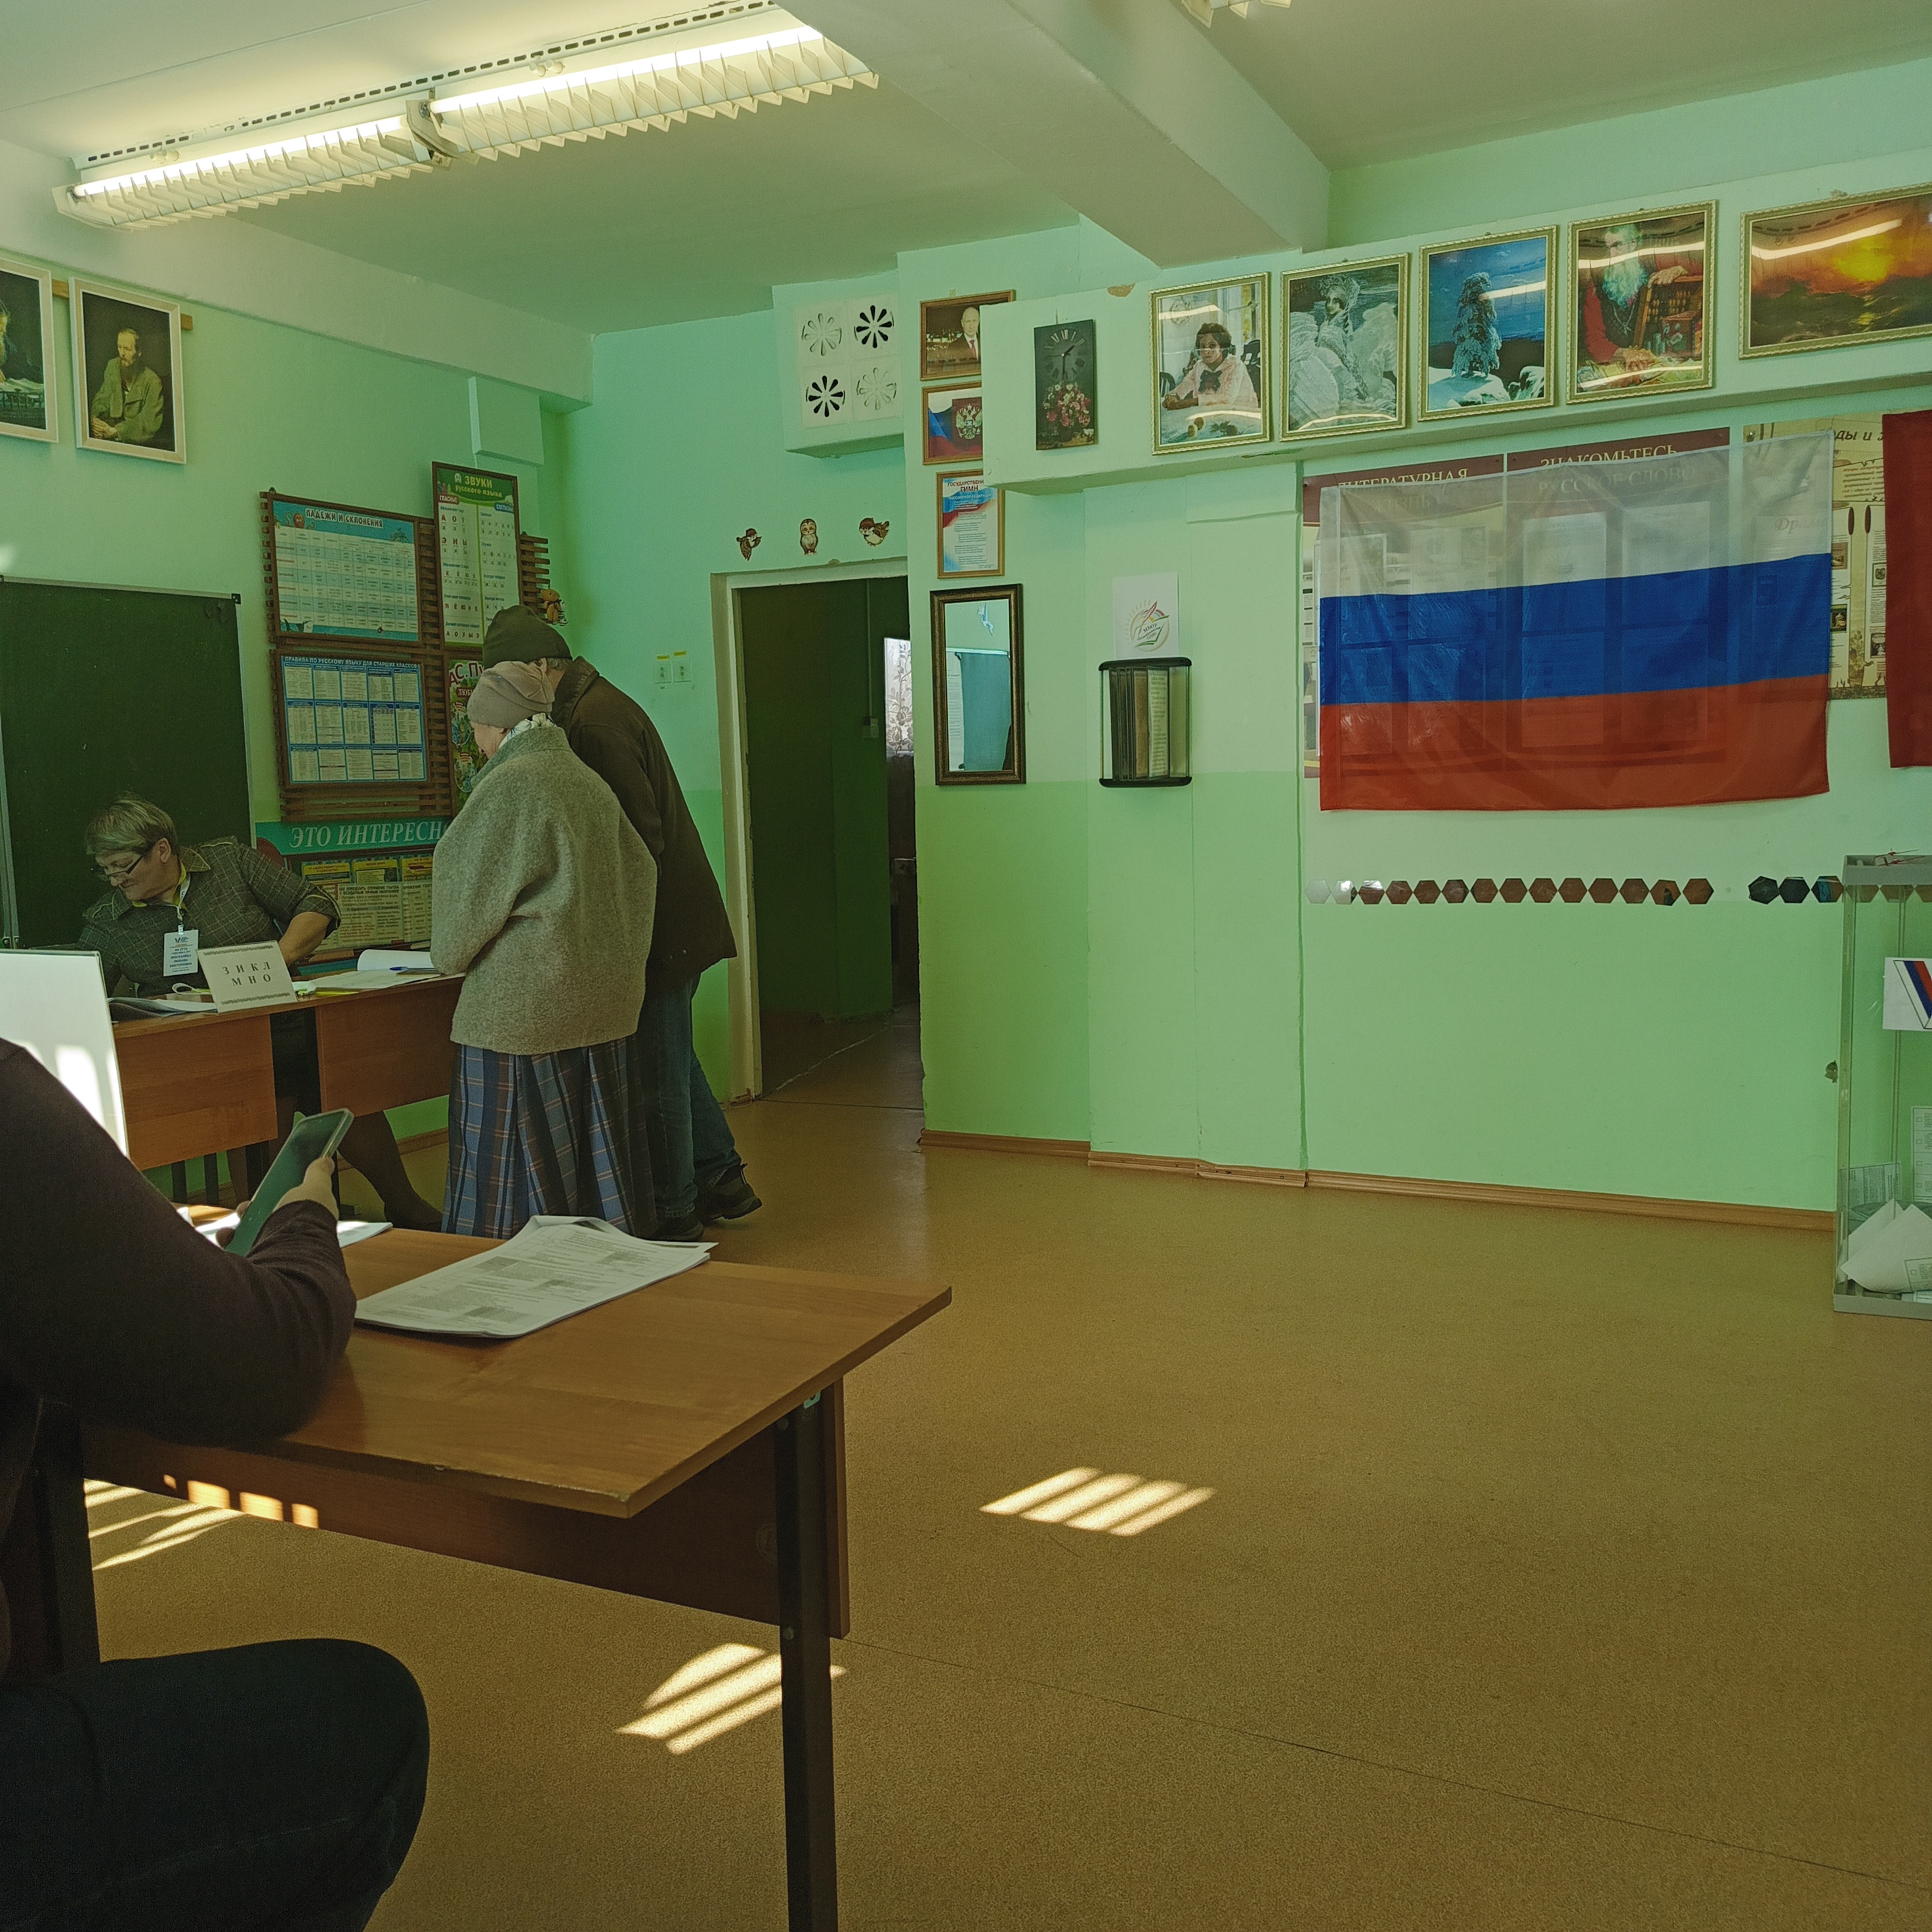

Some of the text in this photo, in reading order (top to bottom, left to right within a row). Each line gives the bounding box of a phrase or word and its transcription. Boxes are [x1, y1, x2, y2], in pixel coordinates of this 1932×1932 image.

[465, 475, 493, 489] ЗВУКИ
[1338, 469, 1469, 486] РАТУРНАЯ
[482, 489, 503, 498] языка
[306, 509, 383, 528] ПАДЕЖИ И СКЛОНЕНИЯ
[289, 826, 331, 848] ЭТО
[222, 961, 270, 975] З И К Л
[231, 974, 271, 986] М Н О
